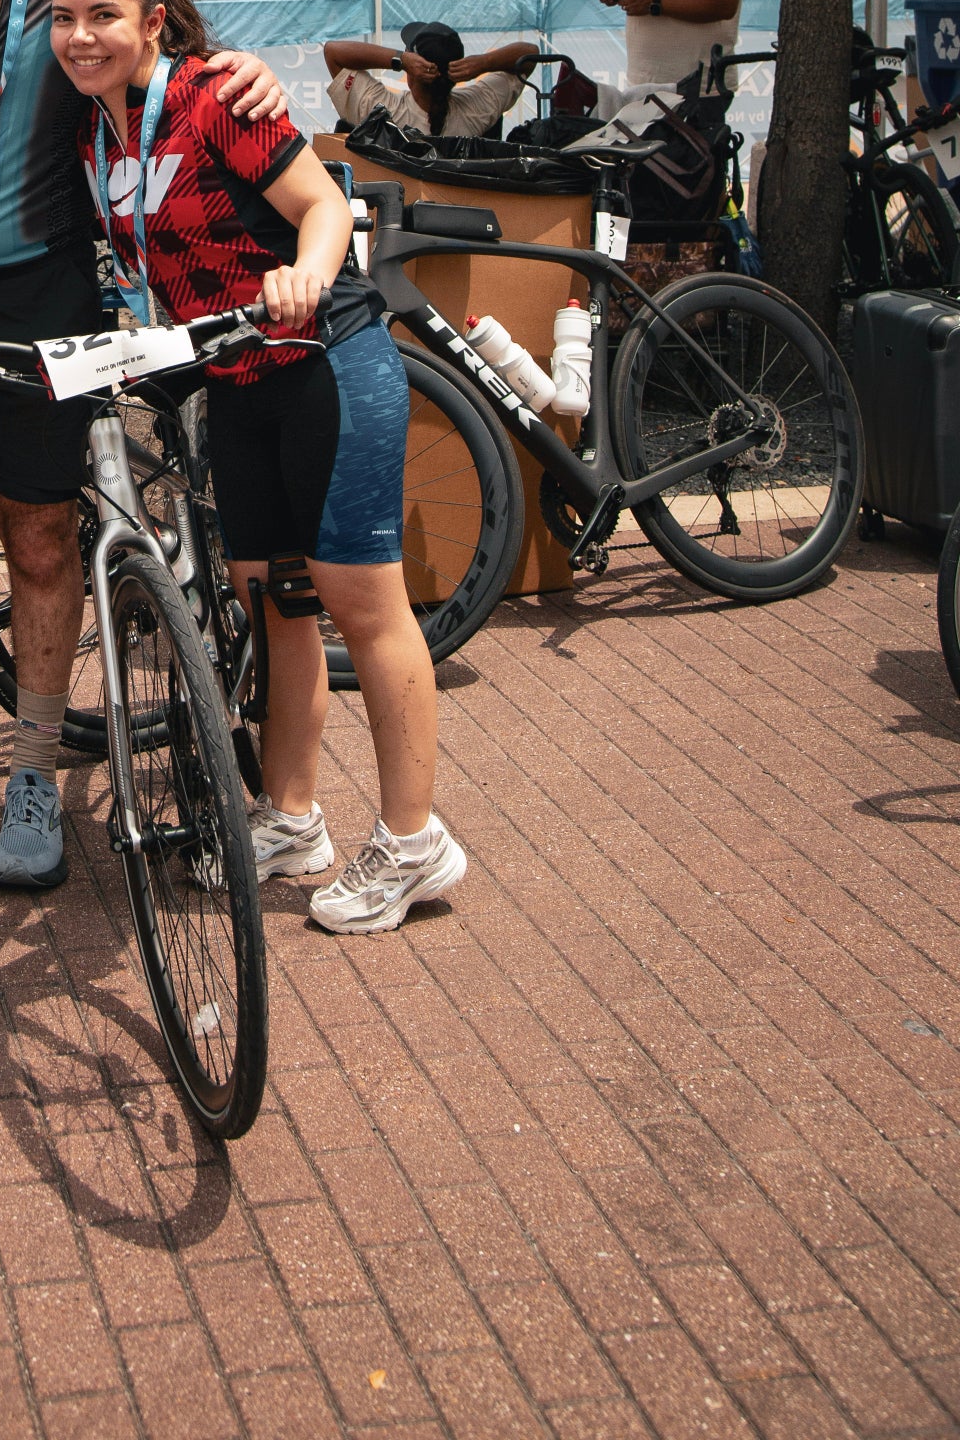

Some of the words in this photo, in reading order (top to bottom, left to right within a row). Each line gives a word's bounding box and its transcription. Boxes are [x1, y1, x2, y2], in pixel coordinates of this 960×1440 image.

[148, 97, 159, 116] ACC
[144, 119, 155, 146] TEXAS
[85, 154, 184, 219] NOV
[426, 303, 542, 432] TREK
